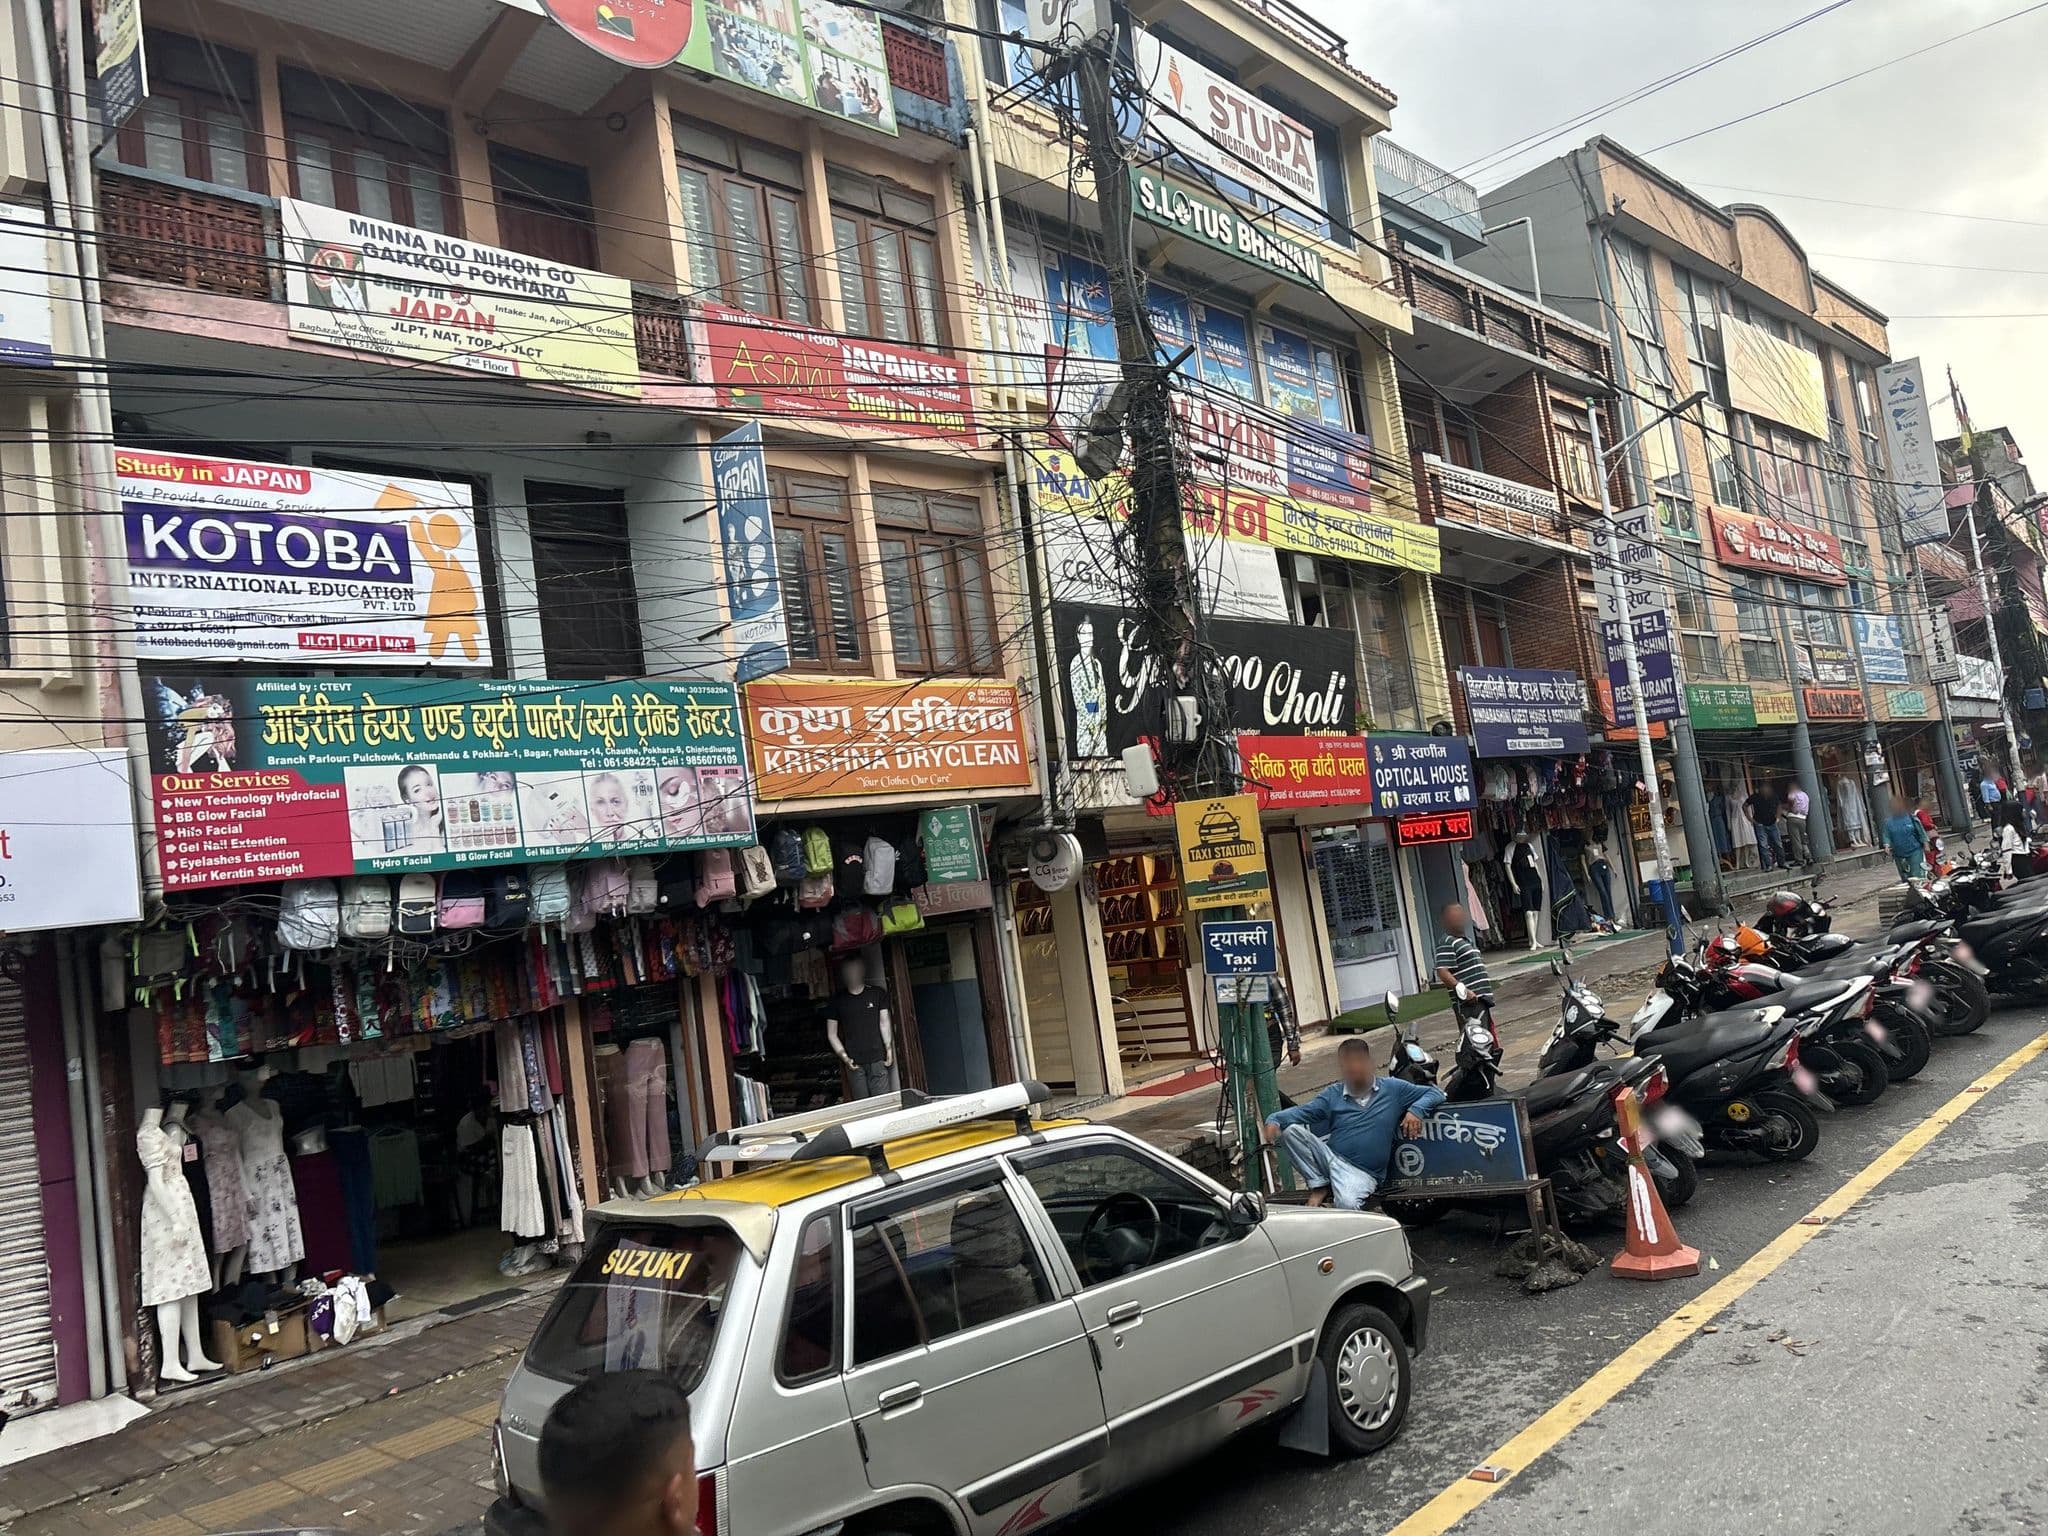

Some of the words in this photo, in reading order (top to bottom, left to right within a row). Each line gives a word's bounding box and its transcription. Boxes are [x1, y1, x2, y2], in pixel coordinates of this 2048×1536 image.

[1207, 85, 1313, 177] STUPA
[1211, 127, 1265, 167] EDUCATIONAL
[1266, 154, 1315, 194] CONSULTANCY
[349, 218, 426, 251] MINNA
[434, 238, 466, 260] NO
[473, 248, 540, 278] NIHON
[547, 267, 575, 285] GO
[1236, 221, 1320, 282] BHAWAN
[363, 242, 460, 278] GAKKOU
[468, 266, 569, 302] POKHARA
[1061, 280, 1089, 310] UK
[390, 297, 496, 335] JAPAN
[495, 304, 527, 318] Intake:
[528, 312, 548, 323] Jan,
[550, 317, 572, 329] April,
[596, 325, 629, 340] October
[1148, 314, 1177, 335] USA
[391, 322, 428, 339] JLPT,
[432, 329, 462, 345] NAT,
[511, 344, 544, 359] JLCT
[1206, 336, 1241, 357] CANADA
[482, 360, 509, 374] Floor
[728, 340, 840, 399] Asahi
[842, 345, 958, 388] JAPANESE
[1269, 356, 1308, 377] Australia
[847, 388, 898, 421] Study
[1292, 441, 1338, 463] Australia
[117, 456, 184, 481] Study
[192, 466, 213, 482] in
[220, 467, 301, 490] JAPAN
[1314, 462, 1335, 473] CANADA
[716, 455, 761, 518] JAPAN
[121, 486, 143, 499] We
[152, 488, 205, 504] Provide
[214, 494, 268, 509] Genuine
[142, 513, 400, 575] KOTOBA
[131, 572, 301, 595] INTERNATIONAL
[309, 582, 415, 601] EDUCATION
[363, 600, 389, 611] PVT.
[394, 601, 416, 612] LTD
[1606, 615, 1664, 640] HTEL
[302, 636, 333, 647] JLCT
[342, 638, 374, 650] JLPT
[384, 639, 410, 651] NAT
[1639, 660, 1648, 678] &
[256, 682, 297, 692] Affilited
[299, 682, 313, 694] by
[319, 682, 352, 692] CTEVT
[518, 684, 527, 692] is
[669, 685, 688, 693] PAN:
[1262, 660, 1347, 727] Choli
[1614, 677, 1673, 704] RESURANT
[259, 692, 355, 751] आईरीस
[361, 691, 417, 747] हेयर
[421, 700, 466, 740] एण्ड
[758, 705, 853, 745] कृष्णा
[267, 755, 305, 766] Branch
[308, 754, 350, 765] Parlour:
[352, 752, 404, 764] Pulchowk,
[406, 751, 460, 762] Kathmandu
[463, 750, 471, 760] &
[524, 749, 551, 760] Bagar,
[553, 747, 604, 758] Pokhara-14,
[605, 746, 641, 757] Chauthe,
[685, 745, 736, 755] Chipledhunga
[580, 758, 598, 769] Tel
[685, 754, 738, 766] 9856076109
[762, 747, 890, 776] KRISHNA
[895, 742, 1021, 770] DRYCLEAN
[1391, 744, 1407, 761] श्री
[724, 767, 739, 775] AFTER
[880, 773, 910, 789] Clothes
[910, 773, 928, 786] Our
[1287, 758, 1310, 784] सुन
[1338, 757, 1367, 777] पसल
[1375, 766, 1428, 788] OPTICAL
[1430, 764, 1469, 785] HOUSE
[161, 776, 202, 792] Our
[210, 773, 290, 789] Services
[174, 799, 202, 808] New
[205, 794, 273, 809] Technology
[275, 789, 340, 803] Hydrofacial
[1402, 792, 1432, 806] चश्मा
[1434, 790, 1452, 804] घर
[175, 813, 195, 823] BB
[197, 811, 228, 821] Glow
[230, 808, 266, 819] Facial
[206, 823, 243, 835] Facial
[178, 842, 200, 854] Gel
[203, 840, 228, 852] Nail
[230, 835, 287, 848] Extention
[525, 848, 539, 857] Gel
[539, 847, 555, 856] Nail
[1190, 849, 1212, 861] TAXI
[1214, 842, 1256, 859] STATION
[179, 856, 242, 870] Eyelashes
[244, 850, 300, 864] Extention
[372, 858, 401, 869] Hydro
[402, 855, 432, 866] Facial
[455, 853, 467, 862] BB
[469, 852, 490, 862] Glow
[490, 850, 513, 860] Facial
[180, 872, 208, 884] Hair
[209, 866, 255, 881] Keratin
[256, 862, 304, 878] Straight
[1035, 864, 1051, 877] CG
[1223, 953, 1257, 966] Taxi
[938, 1110, 976, 1124] LIGHT
[601, 1248, 693, 1280] SUZUKI
